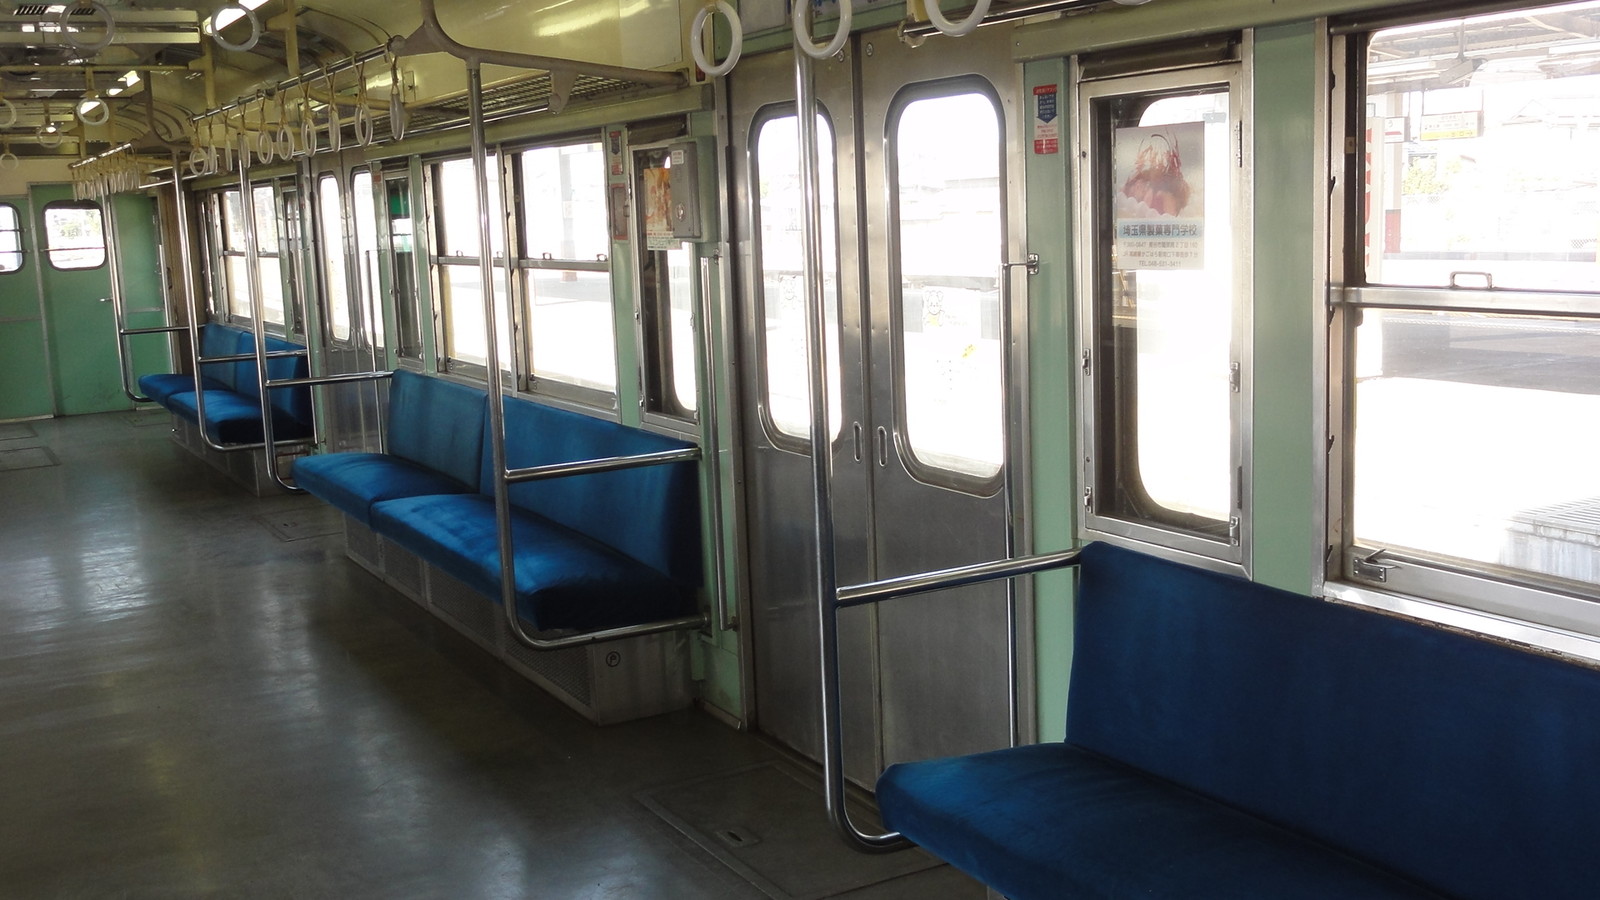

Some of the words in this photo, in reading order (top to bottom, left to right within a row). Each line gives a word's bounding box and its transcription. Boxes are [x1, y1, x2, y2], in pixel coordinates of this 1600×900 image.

[1123, 224, 1198, 236] 埼玉県製菓専門学校
